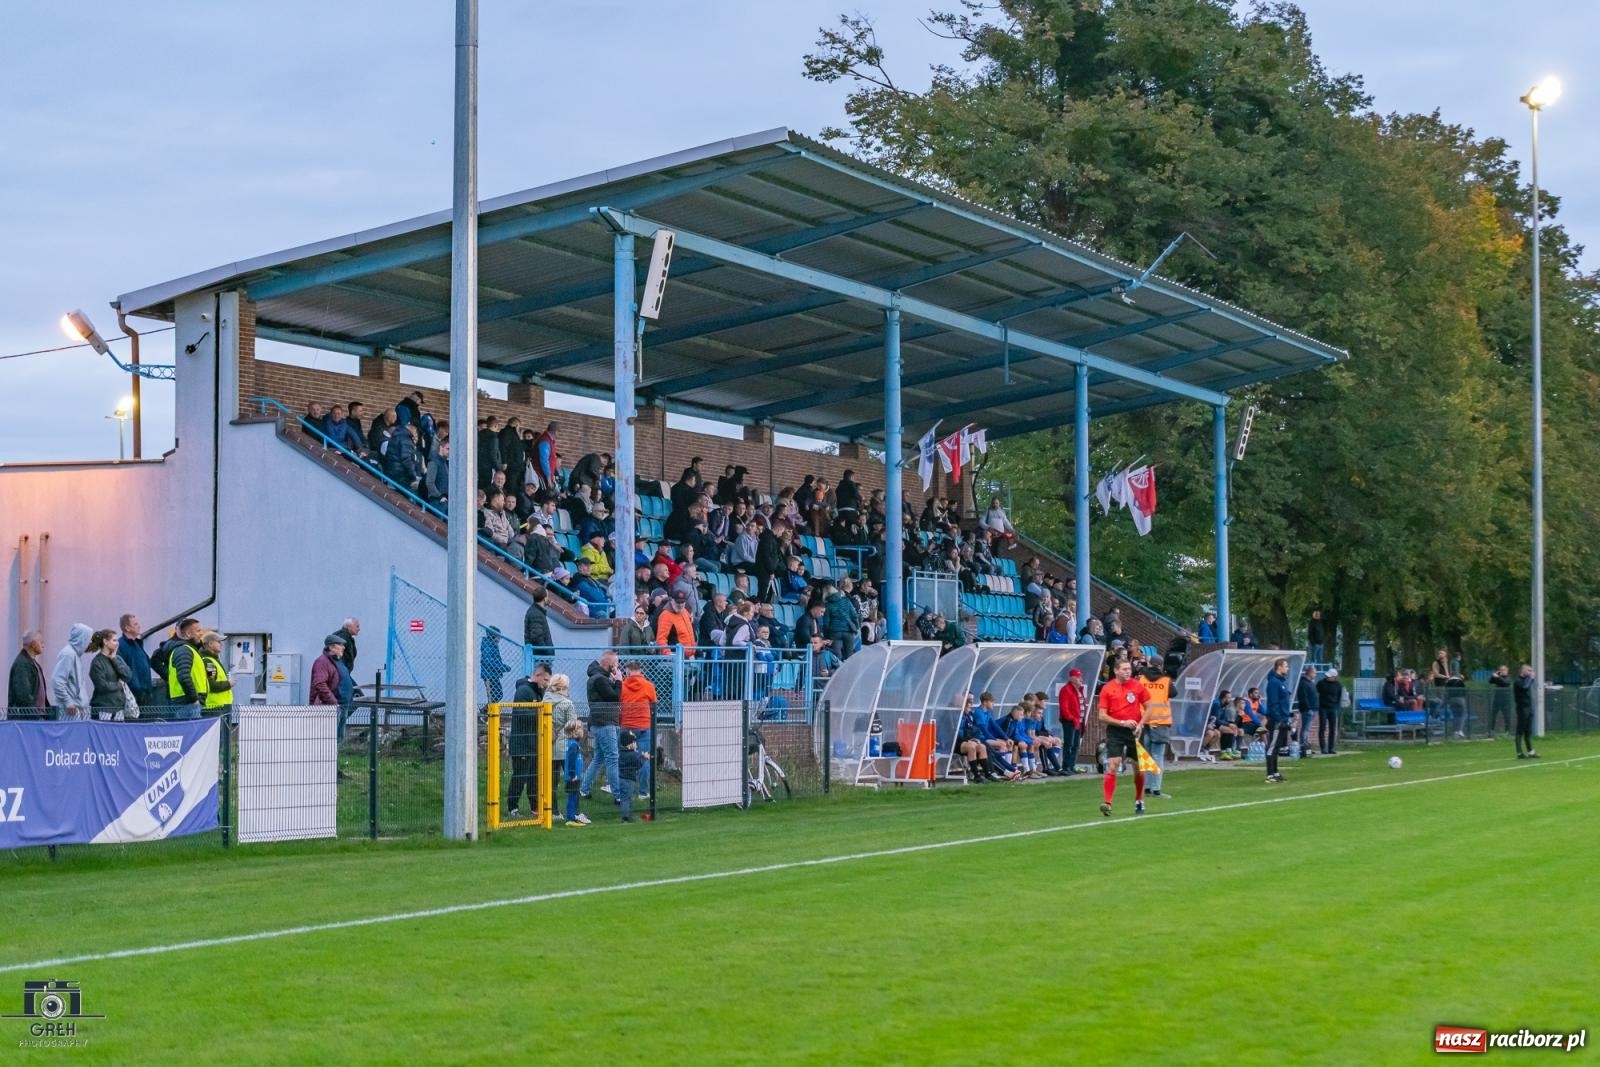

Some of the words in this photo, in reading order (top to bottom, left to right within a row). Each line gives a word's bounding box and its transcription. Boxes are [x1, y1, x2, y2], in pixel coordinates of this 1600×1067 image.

[45, 748, 80, 769] Dołącz
[83, 747, 97, 765] do
[98, 749, 120, 767] nas!
[147, 768, 179, 804] UNIA
